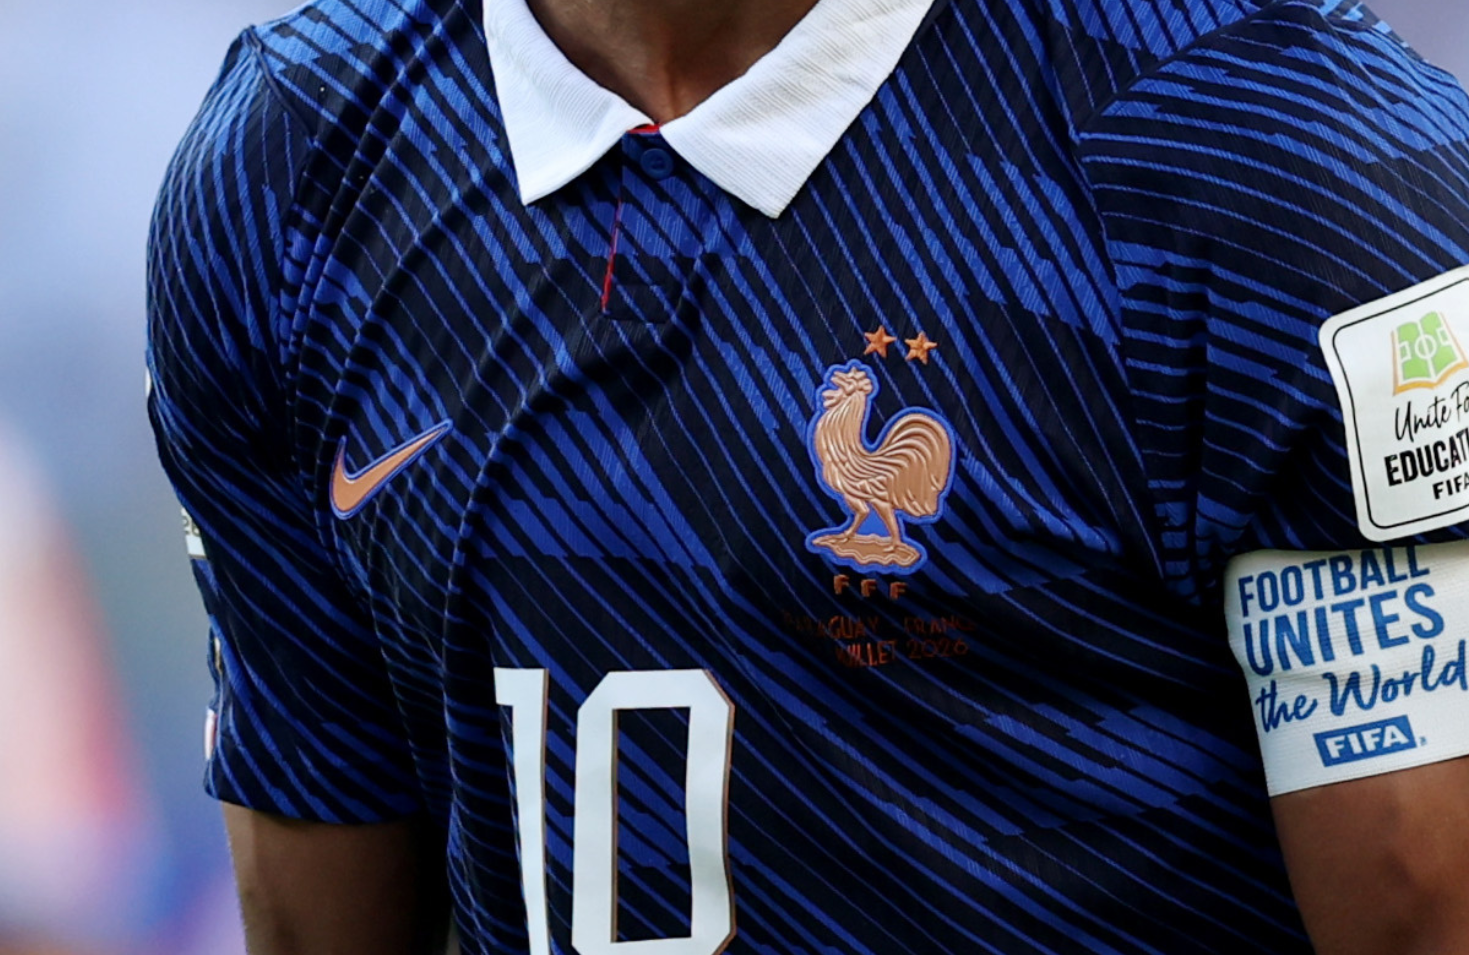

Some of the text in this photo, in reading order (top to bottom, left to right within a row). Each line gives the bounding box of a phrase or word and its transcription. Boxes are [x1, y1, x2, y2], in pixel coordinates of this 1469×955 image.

[1394, 396, 1451, 443] Unite
[1238, 545, 1430, 618] FOOTBALL
[1243, 582, 1445, 677] UNITES
[1255, 639, 1468, 733] the World
[1323, 724, 1410, 759] FIFA
[493, 666, 737, 955] 10
